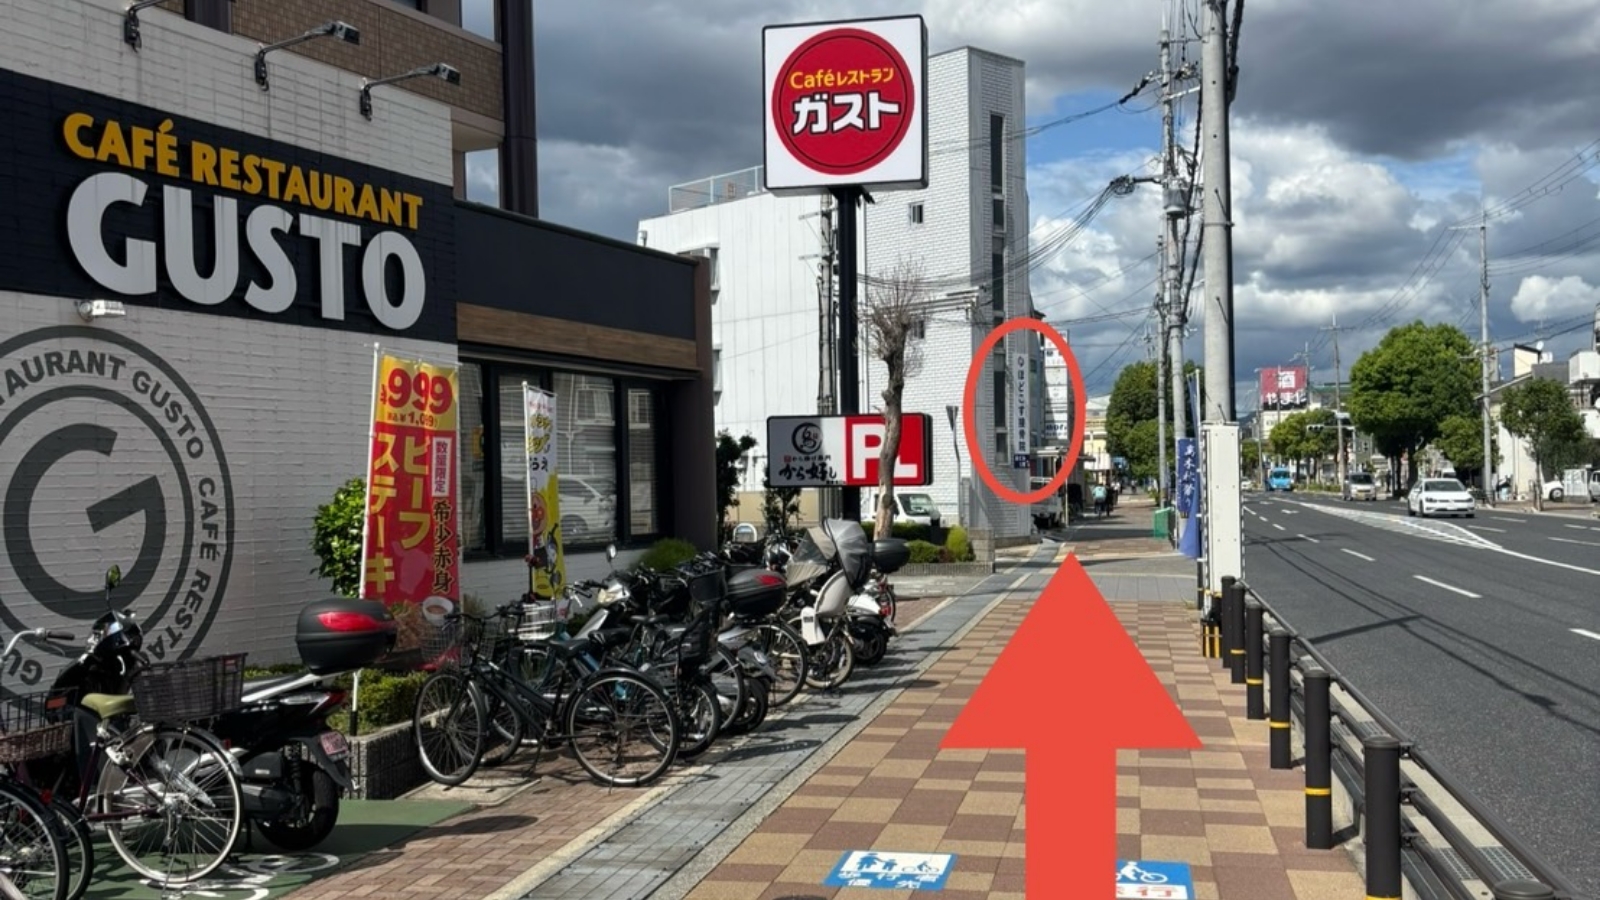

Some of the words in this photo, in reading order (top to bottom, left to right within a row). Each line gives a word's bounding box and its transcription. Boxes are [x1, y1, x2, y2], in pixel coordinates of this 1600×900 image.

[790, 68, 894, 89] Caféレストラン
[793, 91, 900, 135] ガスト
[63, 112, 180, 177] CAFÉ
[191, 140, 423, 230] RESTAURANT
[67, 172, 426, 330] GUSTO
[0, 350, 126, 417] AURANT
[132, 370, 204, 460] GUSTO
[399, 435, 432, 549] ビーフ
[433, 441, 449, 493] 数量限定
[778, 462, 838, 481] から好し
[198, 477, 220, 561] CAFÉ
[365, 432, 399, 593] ステーキ
[432, 500, 454, 593] 希少赤身
[138, 569, 212, 666] RESTA
